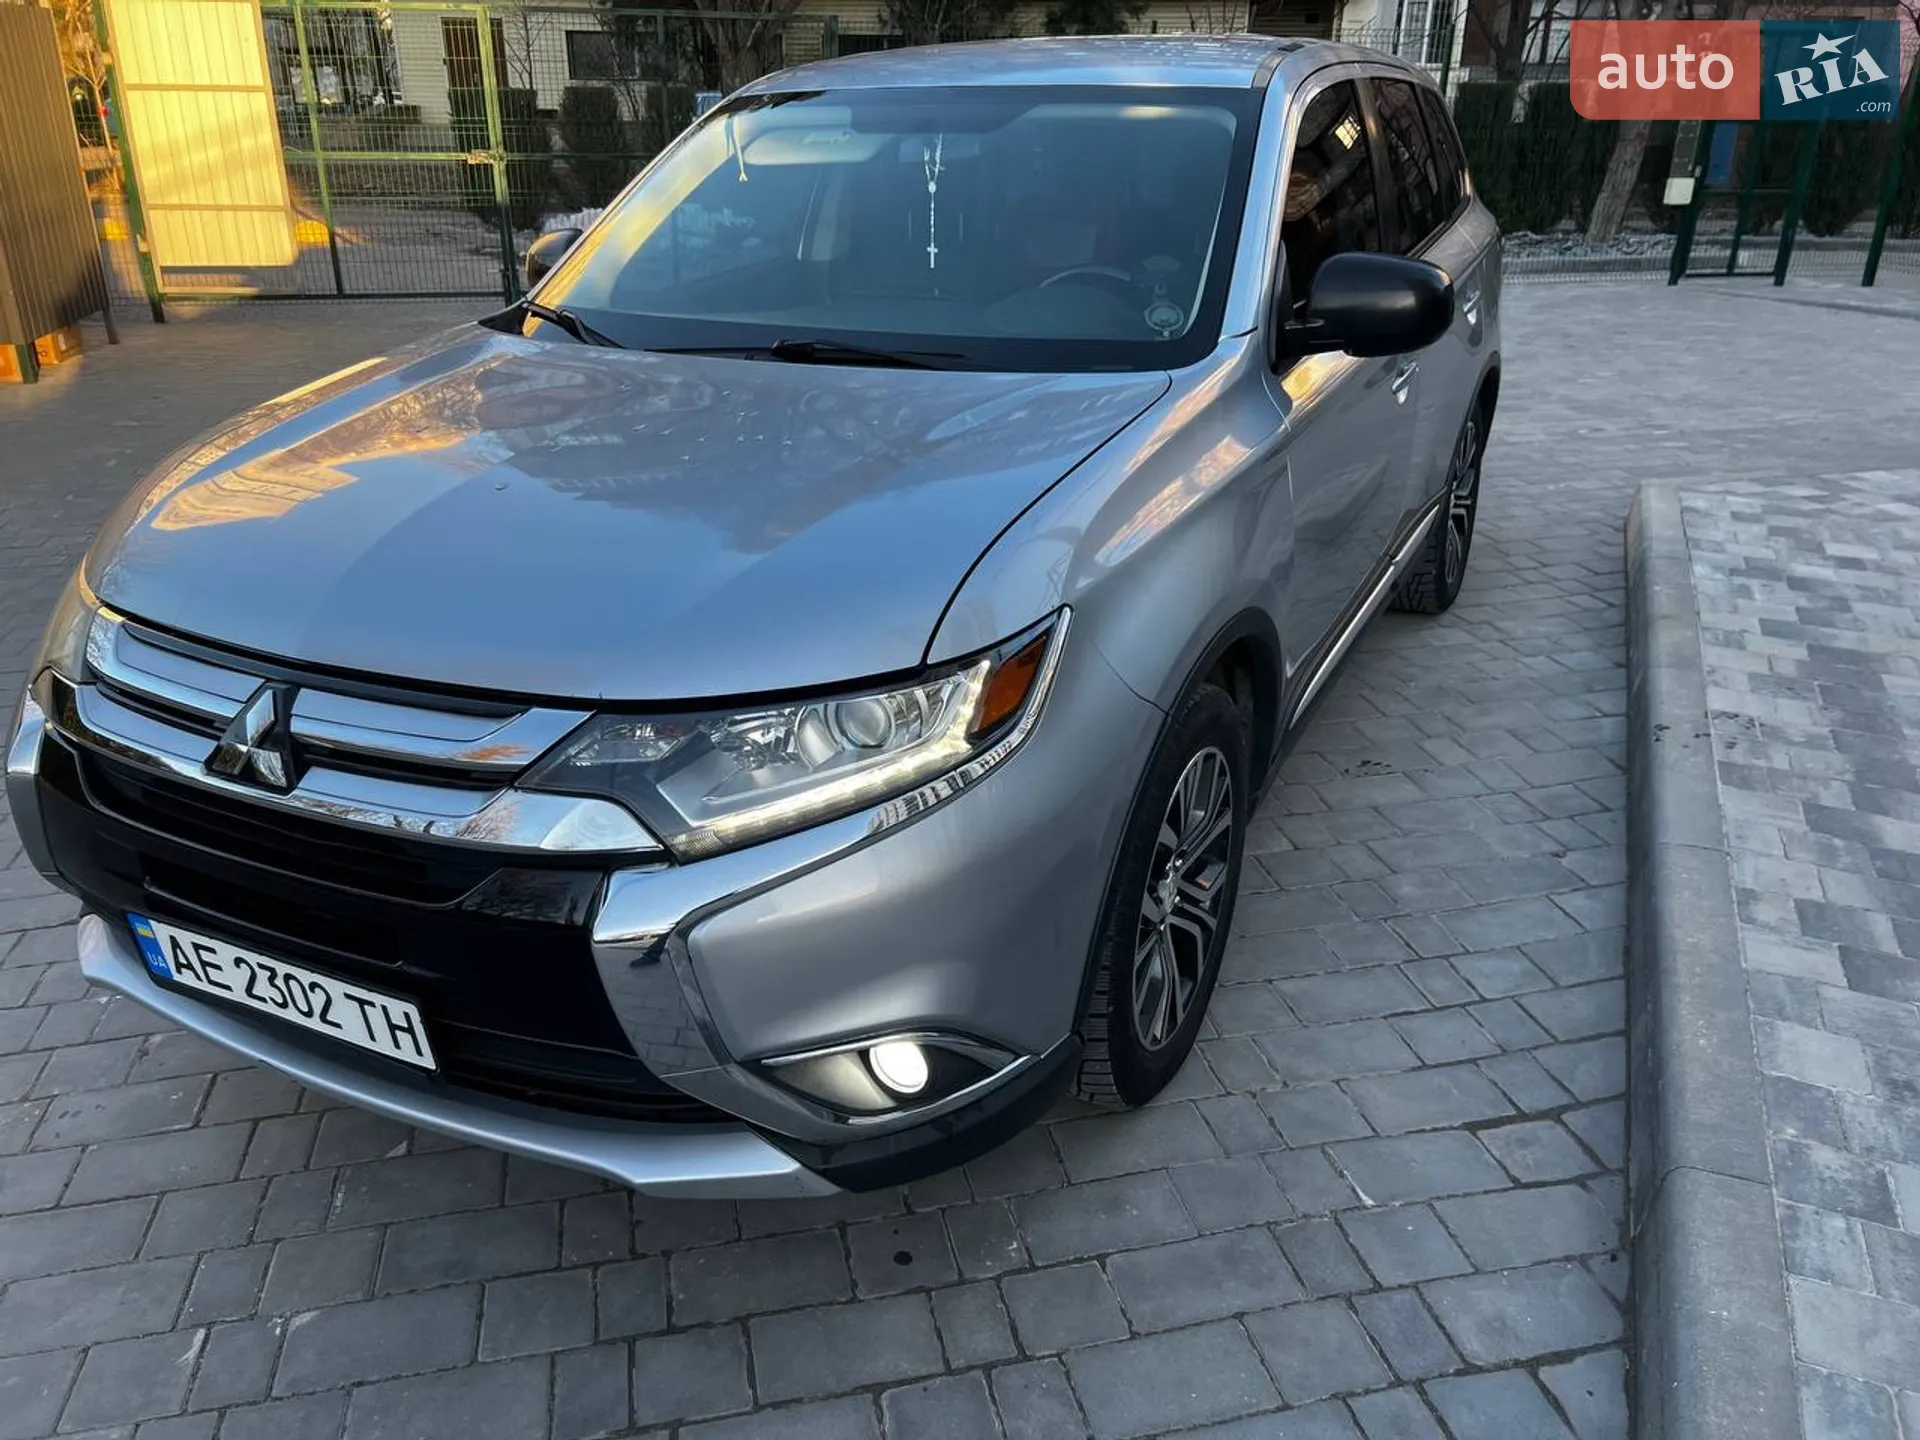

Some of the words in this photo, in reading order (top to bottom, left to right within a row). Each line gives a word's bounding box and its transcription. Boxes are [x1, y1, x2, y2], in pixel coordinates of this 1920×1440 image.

[148, 953, 167, 969] UA
[169, 935, 233, 991] AE
[234, 956, 343, 1029] 2302
[344, 993, 423, 1057] TH
